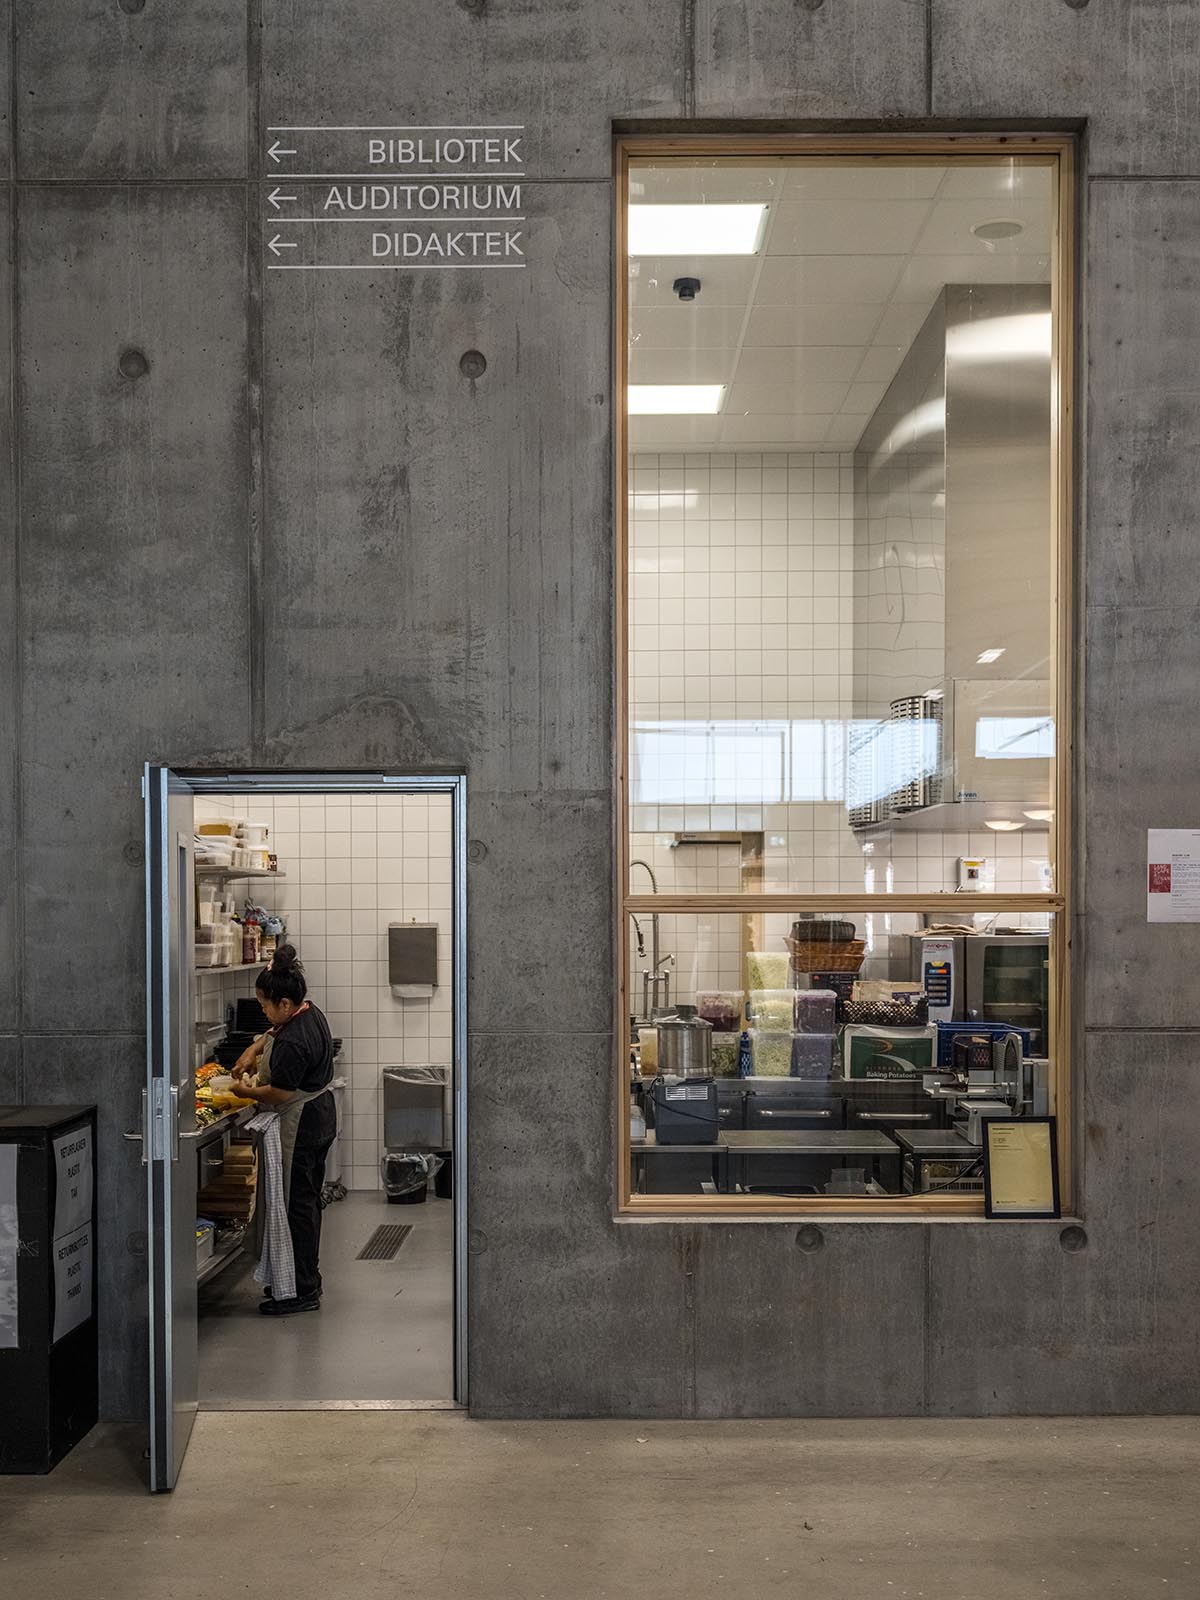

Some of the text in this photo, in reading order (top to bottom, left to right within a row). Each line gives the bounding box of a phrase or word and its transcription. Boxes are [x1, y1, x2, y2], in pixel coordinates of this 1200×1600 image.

[369, 138, 523, 163] BIBLIOTEK
[324, 185, 521, 210] AUDITORIUM
[372, 232, 524, 257] DIDAKTEK
[866, 1071, 916, 1079] Baking Potatoes
